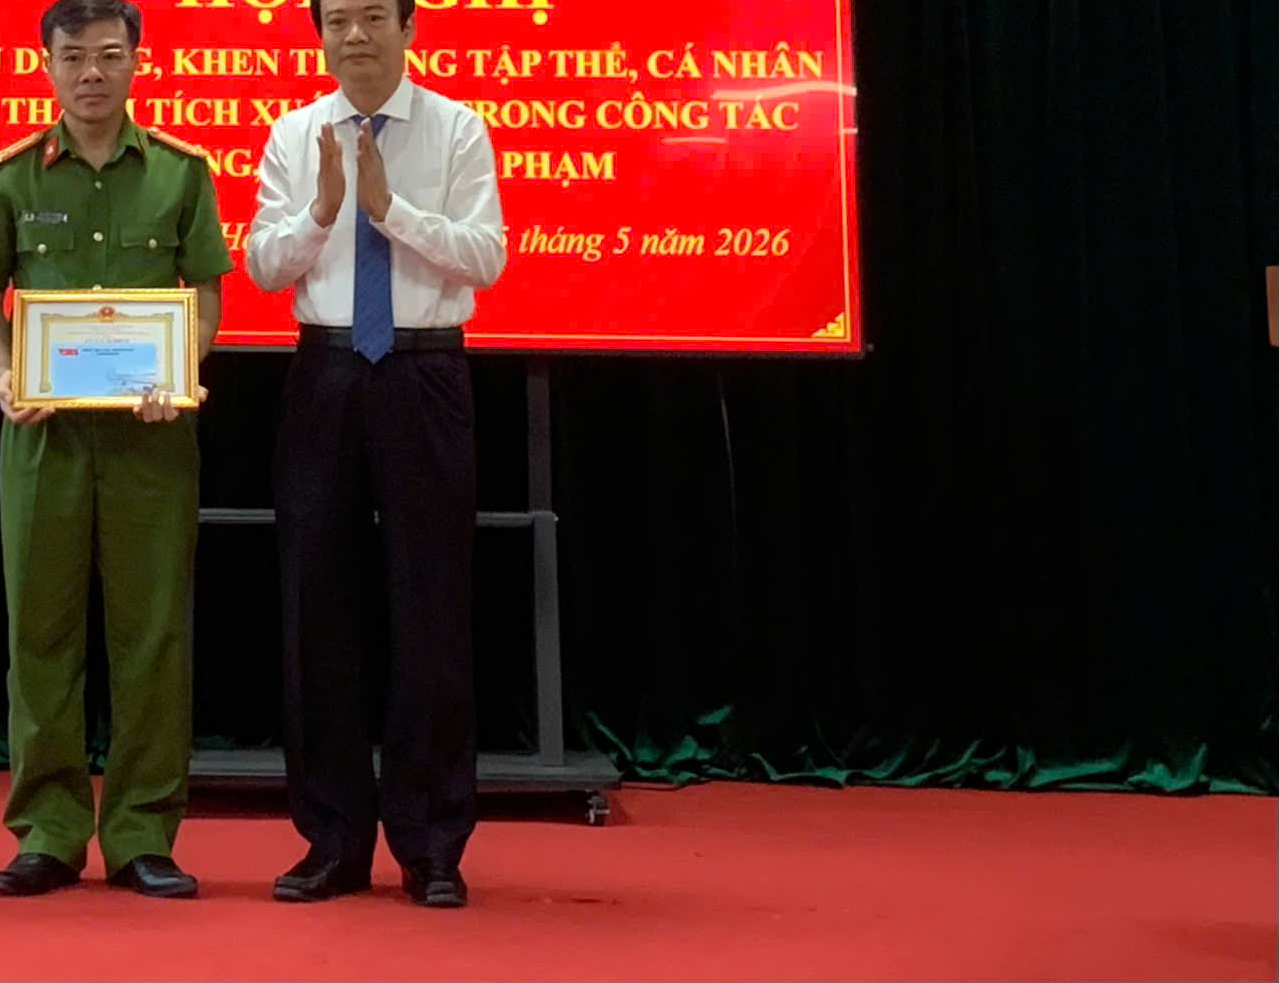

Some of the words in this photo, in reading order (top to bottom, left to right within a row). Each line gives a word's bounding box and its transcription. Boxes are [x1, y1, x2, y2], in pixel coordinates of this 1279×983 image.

[173, 48, 281, 76] KHEN
[466, 45, 542, 85] TẬP
[548, 42, 638, 82] THỂ,
[647, 42, 702, 79] CÁ
[712, 41, 823, 79] NHÂN
[146, 90, 240, 126] TÍCH
[463, 100, 587, 129] RONG
[596, 91, 710, 129] CÔNG
[719, 94, 800, 130] TÁC
[501, 151, 616, 188] PHẠM
[519, 225, 605, 262] tháng
[613, 227, 632, 254] 5
[640, 228, 705, 256] năm
[714, 228, 791, 256] 2026
